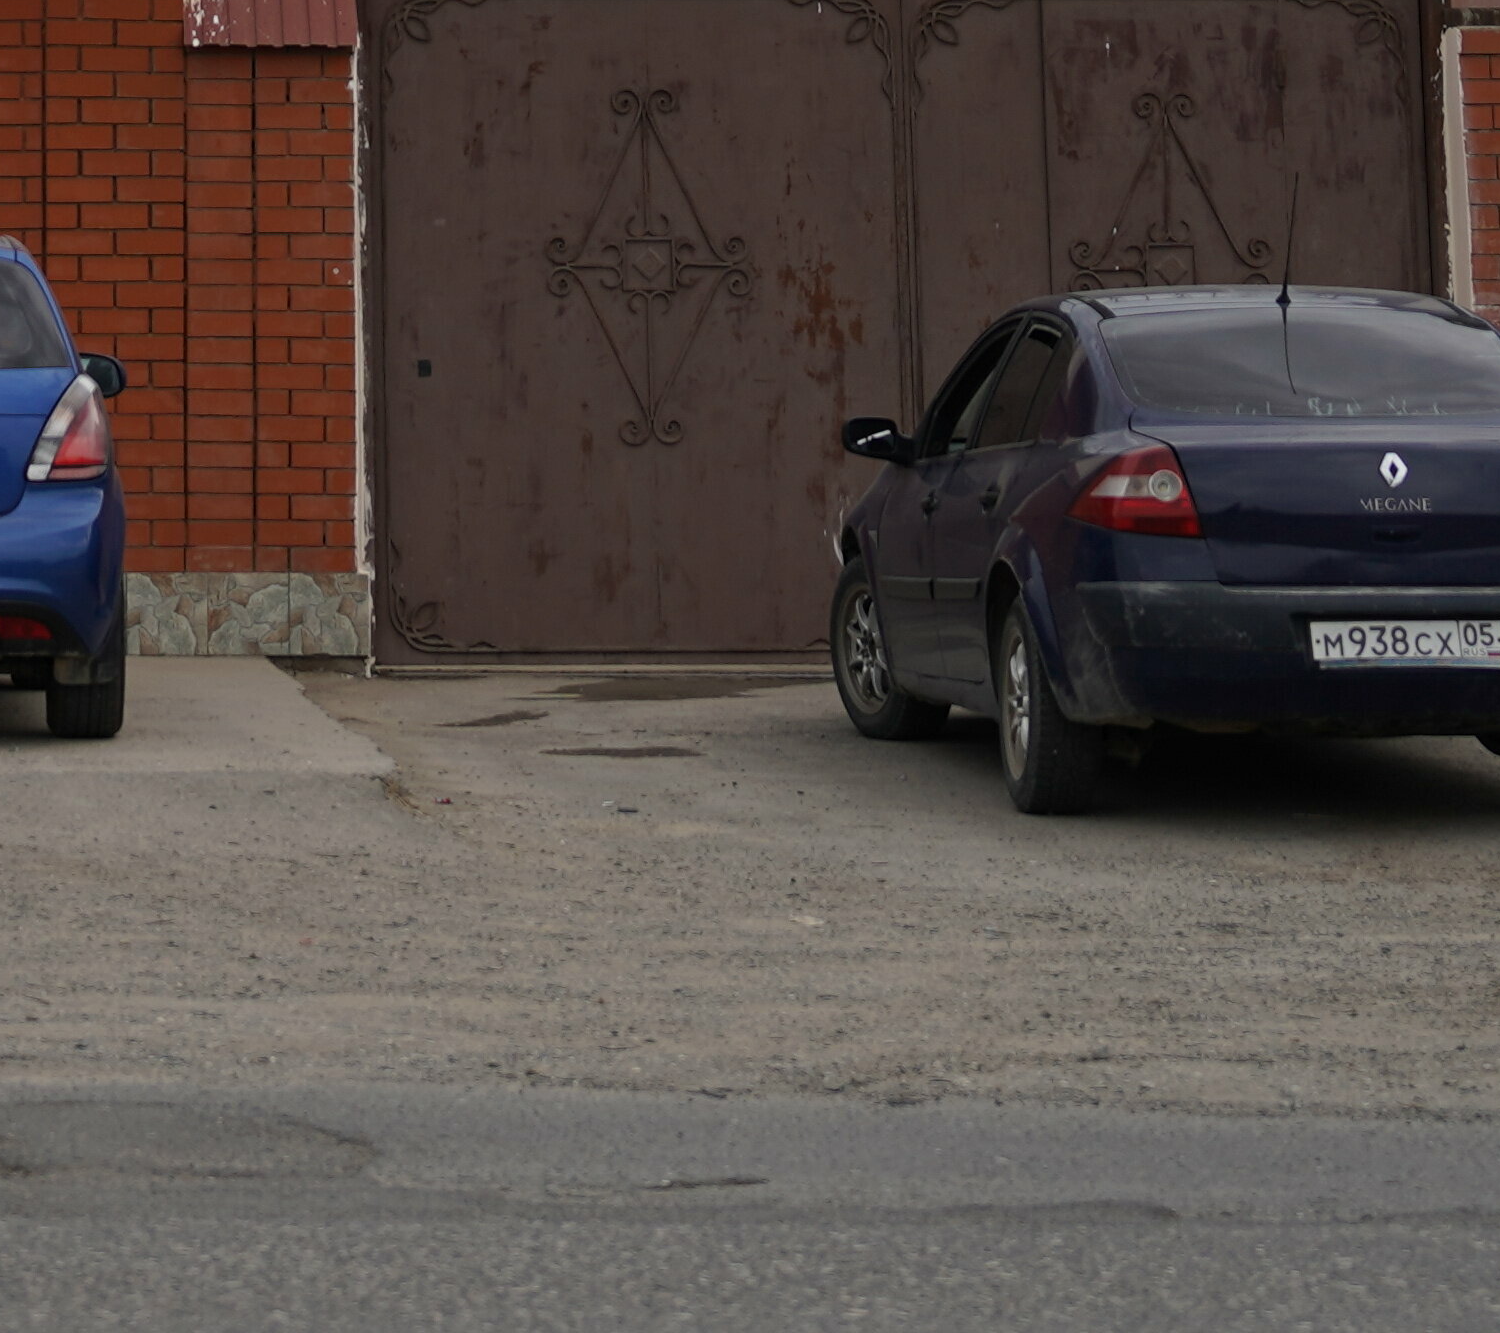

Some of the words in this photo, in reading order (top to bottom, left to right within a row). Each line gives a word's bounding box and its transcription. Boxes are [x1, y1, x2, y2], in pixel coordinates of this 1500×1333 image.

[1360, 497, 1432, 512] MEGANE
[1323, 625, 1455, 657] М938СХ
[1463, 622, 1495, 646] 05
[1463, 647, 1487, 657] RUS
